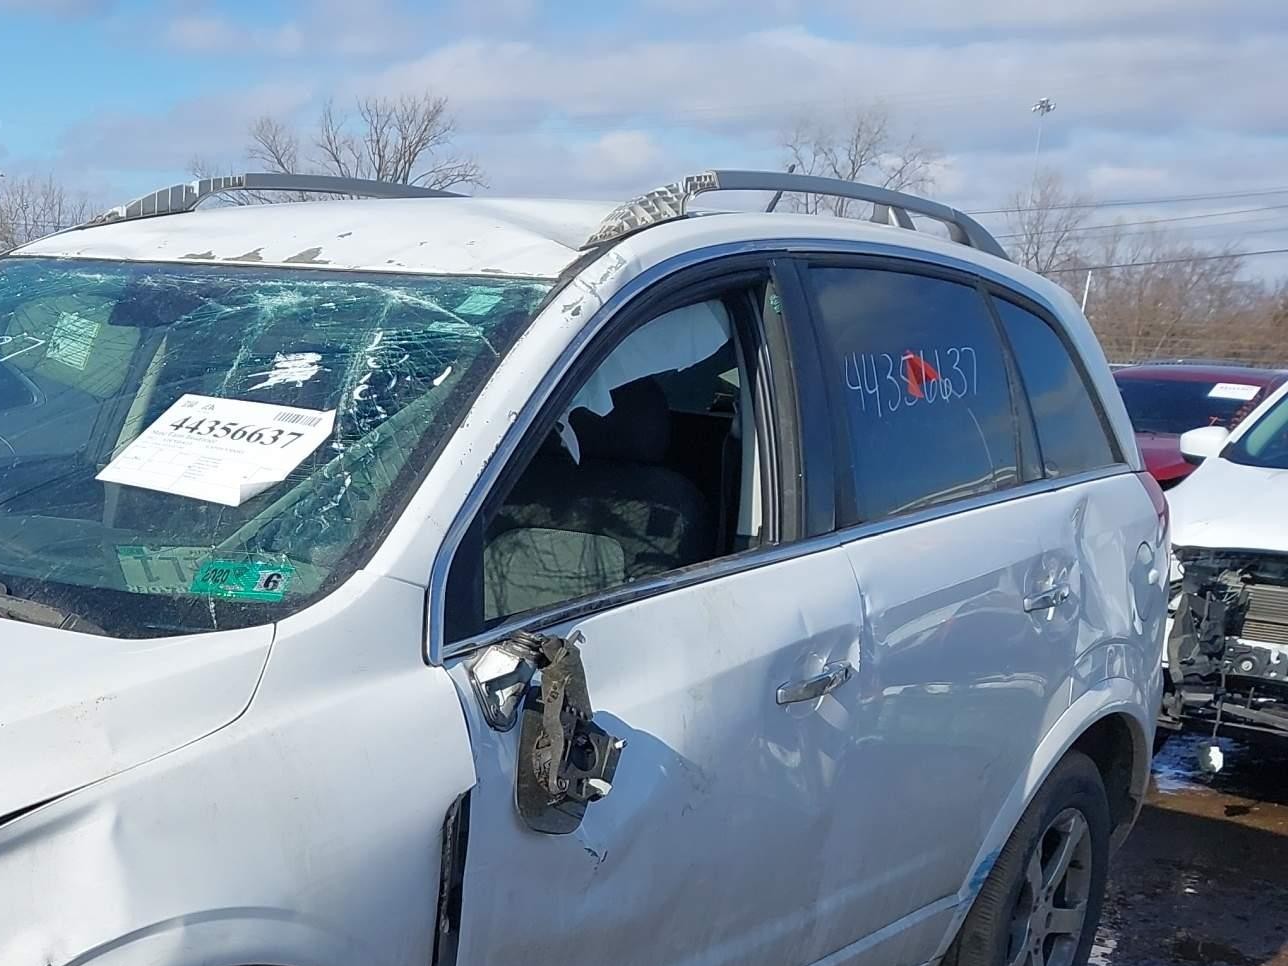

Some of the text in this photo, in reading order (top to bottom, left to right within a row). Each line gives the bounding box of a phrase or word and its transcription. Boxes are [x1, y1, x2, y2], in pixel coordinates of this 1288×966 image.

[844, 347, 977, 418] 44356637
[169, 415, 304, 448] 44356637
[200, 568, 282, 591] 2020 6
